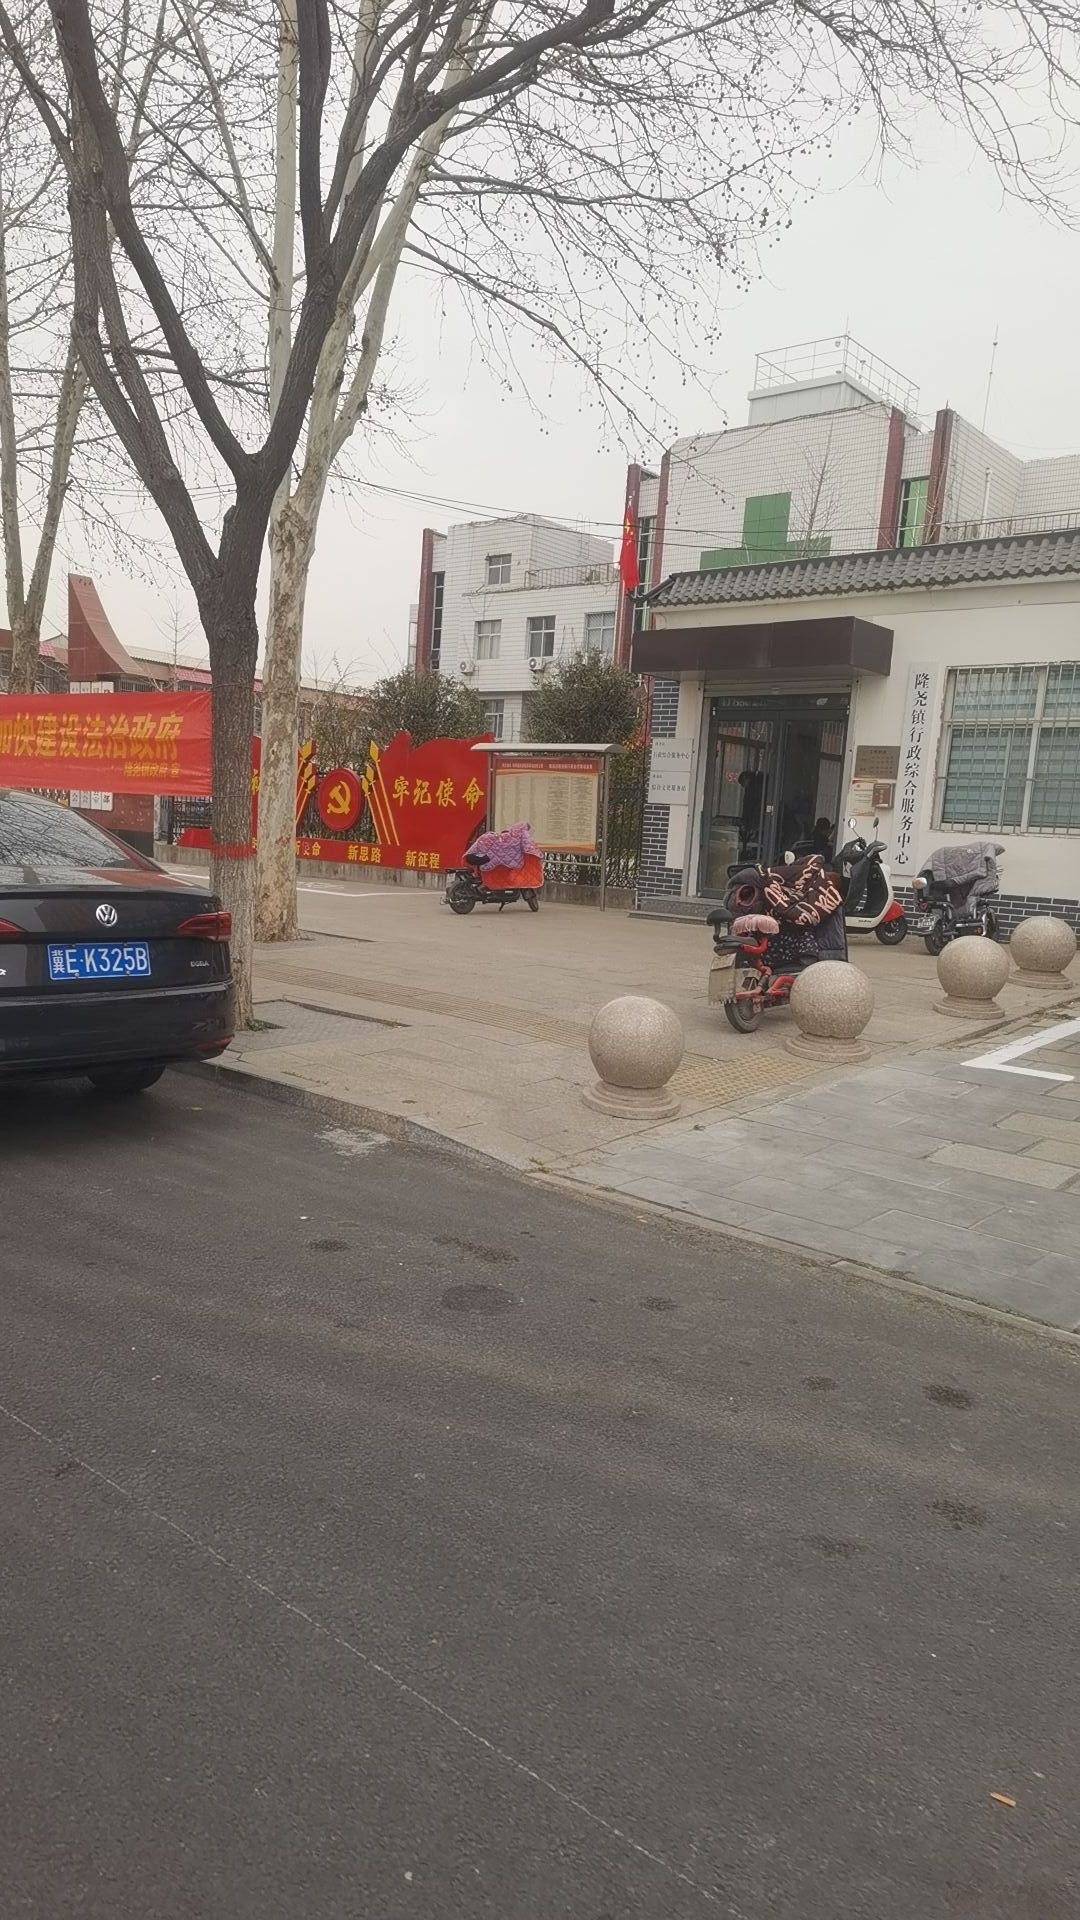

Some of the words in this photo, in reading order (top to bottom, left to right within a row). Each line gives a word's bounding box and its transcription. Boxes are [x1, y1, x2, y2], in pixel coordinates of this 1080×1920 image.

[0, 710, 184, 759] 加快建设法治政府
[894, 672, 930, 865] 隆尧镇行政综合服务中心
[391, 776, 485, 811] 牢记使命
[347, 844, 382, 864] 新思路
[405, 850, 441, 869] 新征程
